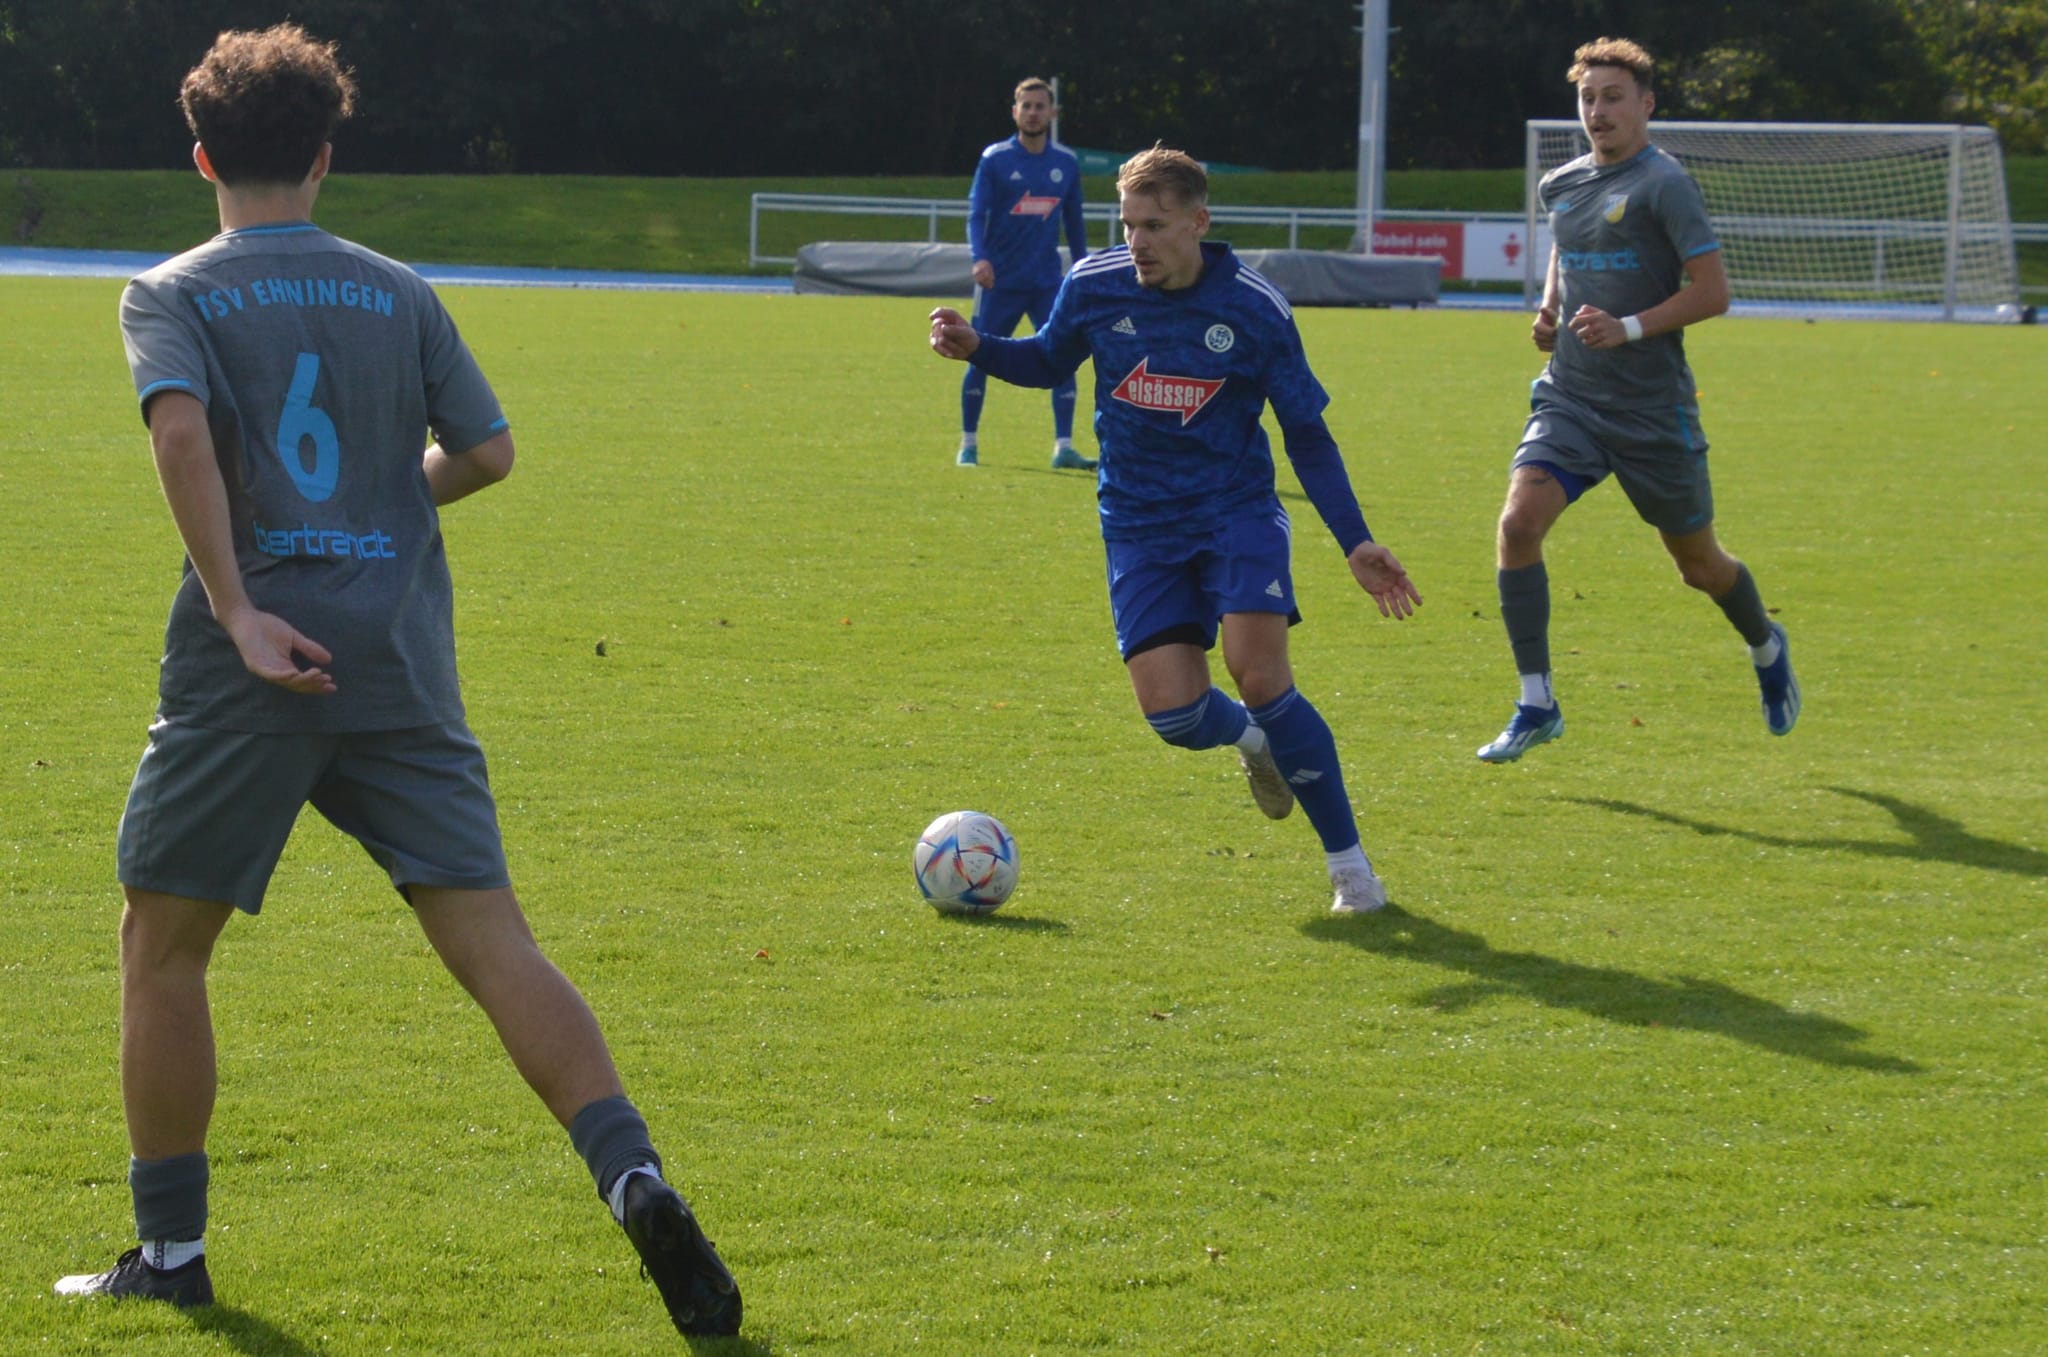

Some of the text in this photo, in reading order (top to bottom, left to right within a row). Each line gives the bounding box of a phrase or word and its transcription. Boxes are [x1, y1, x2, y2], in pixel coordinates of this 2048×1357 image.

[193, 277, 394, 322] TSV EHNINGEN
[1128, 377, 1205, 407] elsässer
[277, 352, 340, 503] 6
